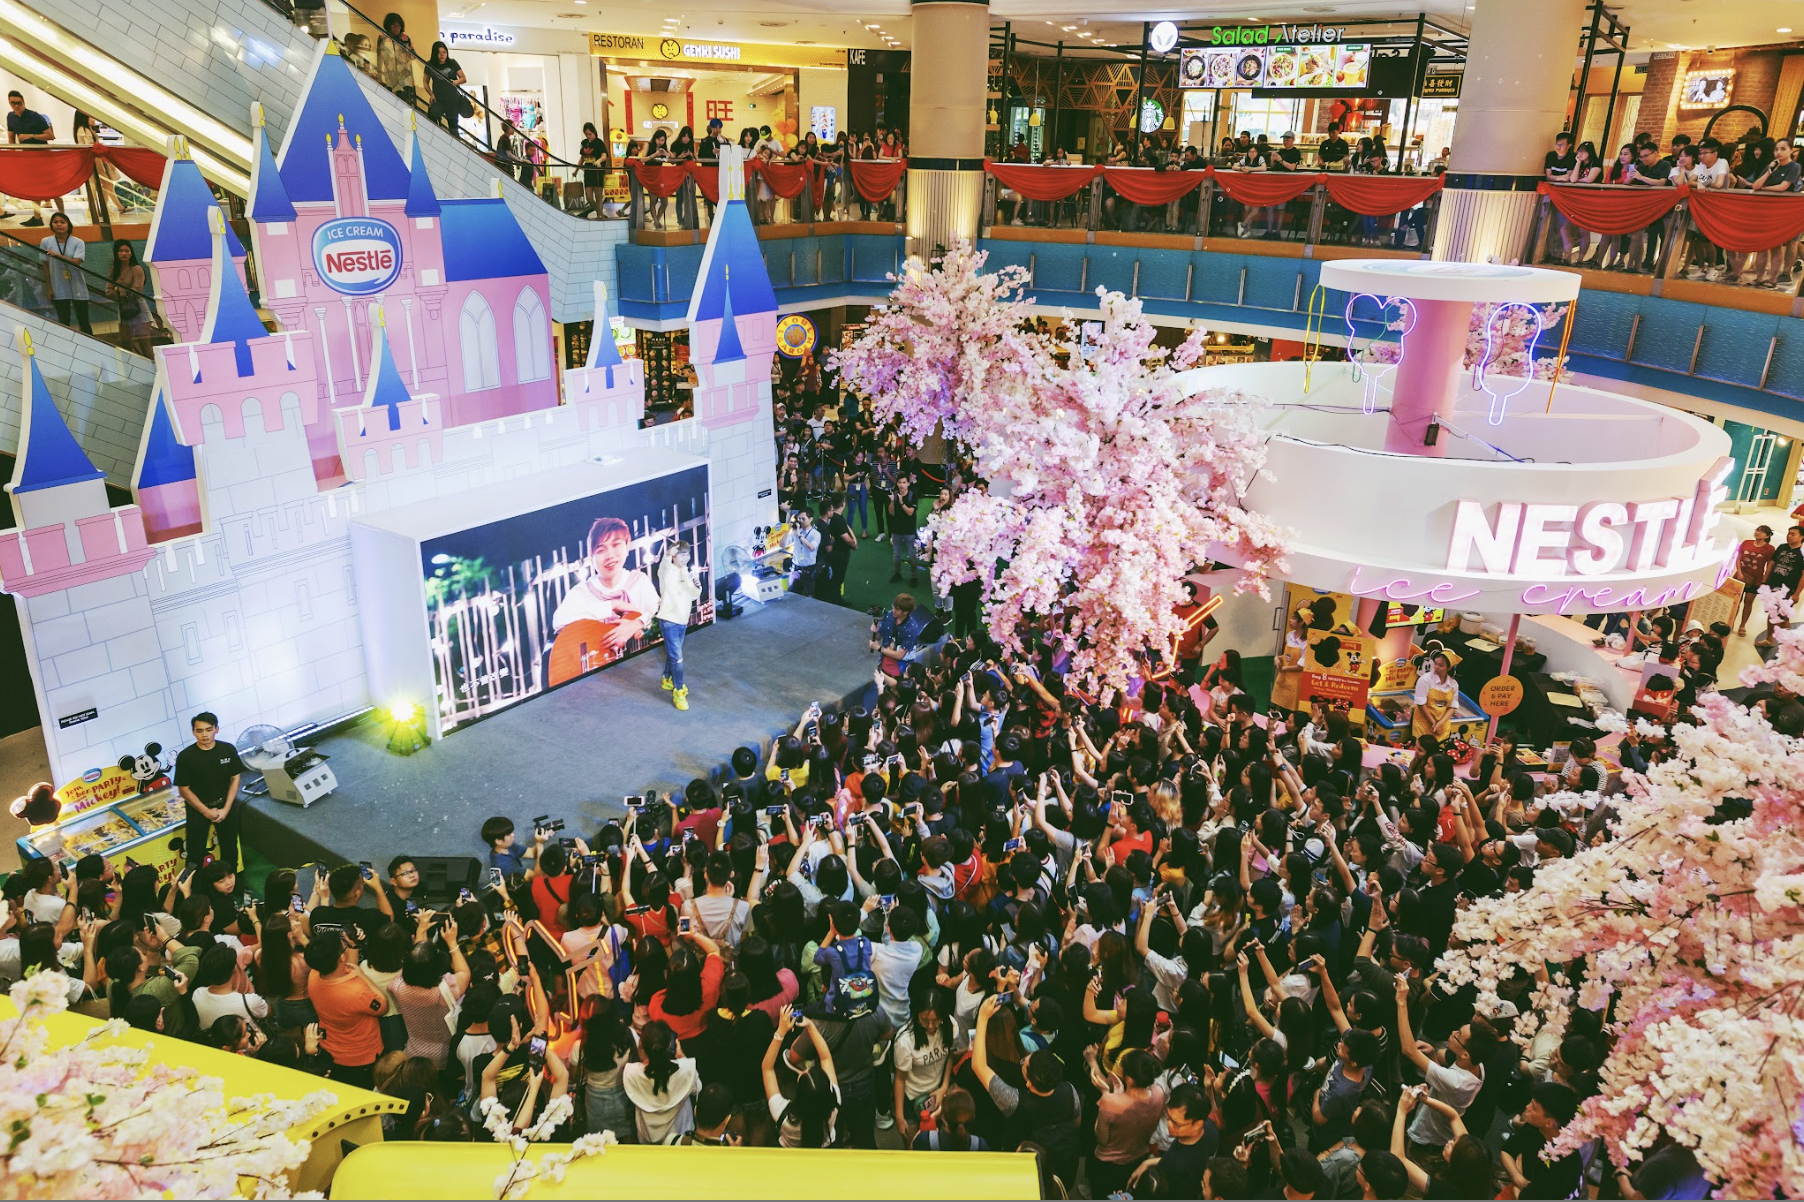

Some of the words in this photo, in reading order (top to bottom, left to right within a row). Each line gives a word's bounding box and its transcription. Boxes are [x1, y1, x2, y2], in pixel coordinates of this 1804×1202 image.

[450, 28, 513, 44] paradise
[593, 34, 644, 49] RESTORAN
[1211, 25, 1269, 45] Salad
[1275, 24, 1346, 43] Atelier
[683, 44, 712, 58] GENKI
[713, 45, 741, 60] SUSHI
[849, 48, 866, 65] KAFE
[706, 100, 734, 121] 旺
[327, 227, 344, 240] ICE
[346, 226, 384, 237] CREAM
[777, 317, 813, 333] SEOUL
[1349, 564, 1482, 603] ice
[1521, 579, 1705, 615] cream
[1322, 672, 1328, 681] 8
[1311, 680, 1323, 688] Get
[1331, 681, 1359, 692] Redeem
[74, 784, 120, 813] Mickey!
[923, 1046, 949, 1066] PARIS
